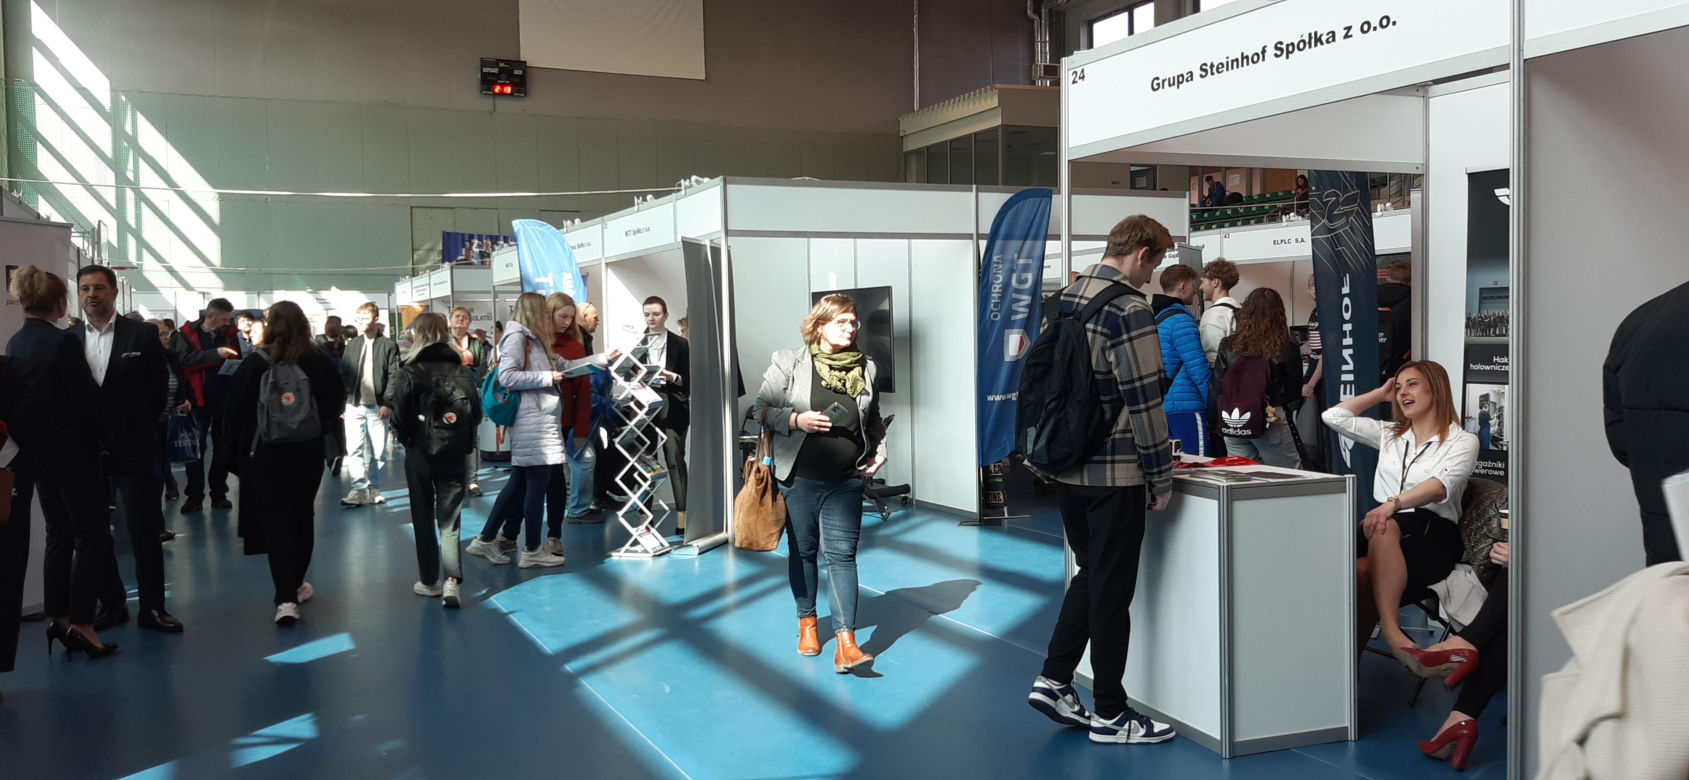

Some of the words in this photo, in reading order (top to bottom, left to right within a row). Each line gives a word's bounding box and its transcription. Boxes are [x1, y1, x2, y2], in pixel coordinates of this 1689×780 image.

[1071, 68, 1086, 85] 24
[1150, 70, 1194, 92] Grupa
[1199, 45, 1267, 79] Steinhof
[1273, 30, 1336, 59] Spółka
[1342, 25, 1353, 40] z
[1359, 14, 1397, 35] o.o.
[990, 254, 1003, 321] OCHRONA
[1010, 253, 1033, 321] WGT
[1221, 427, 1252, 436] adidas
